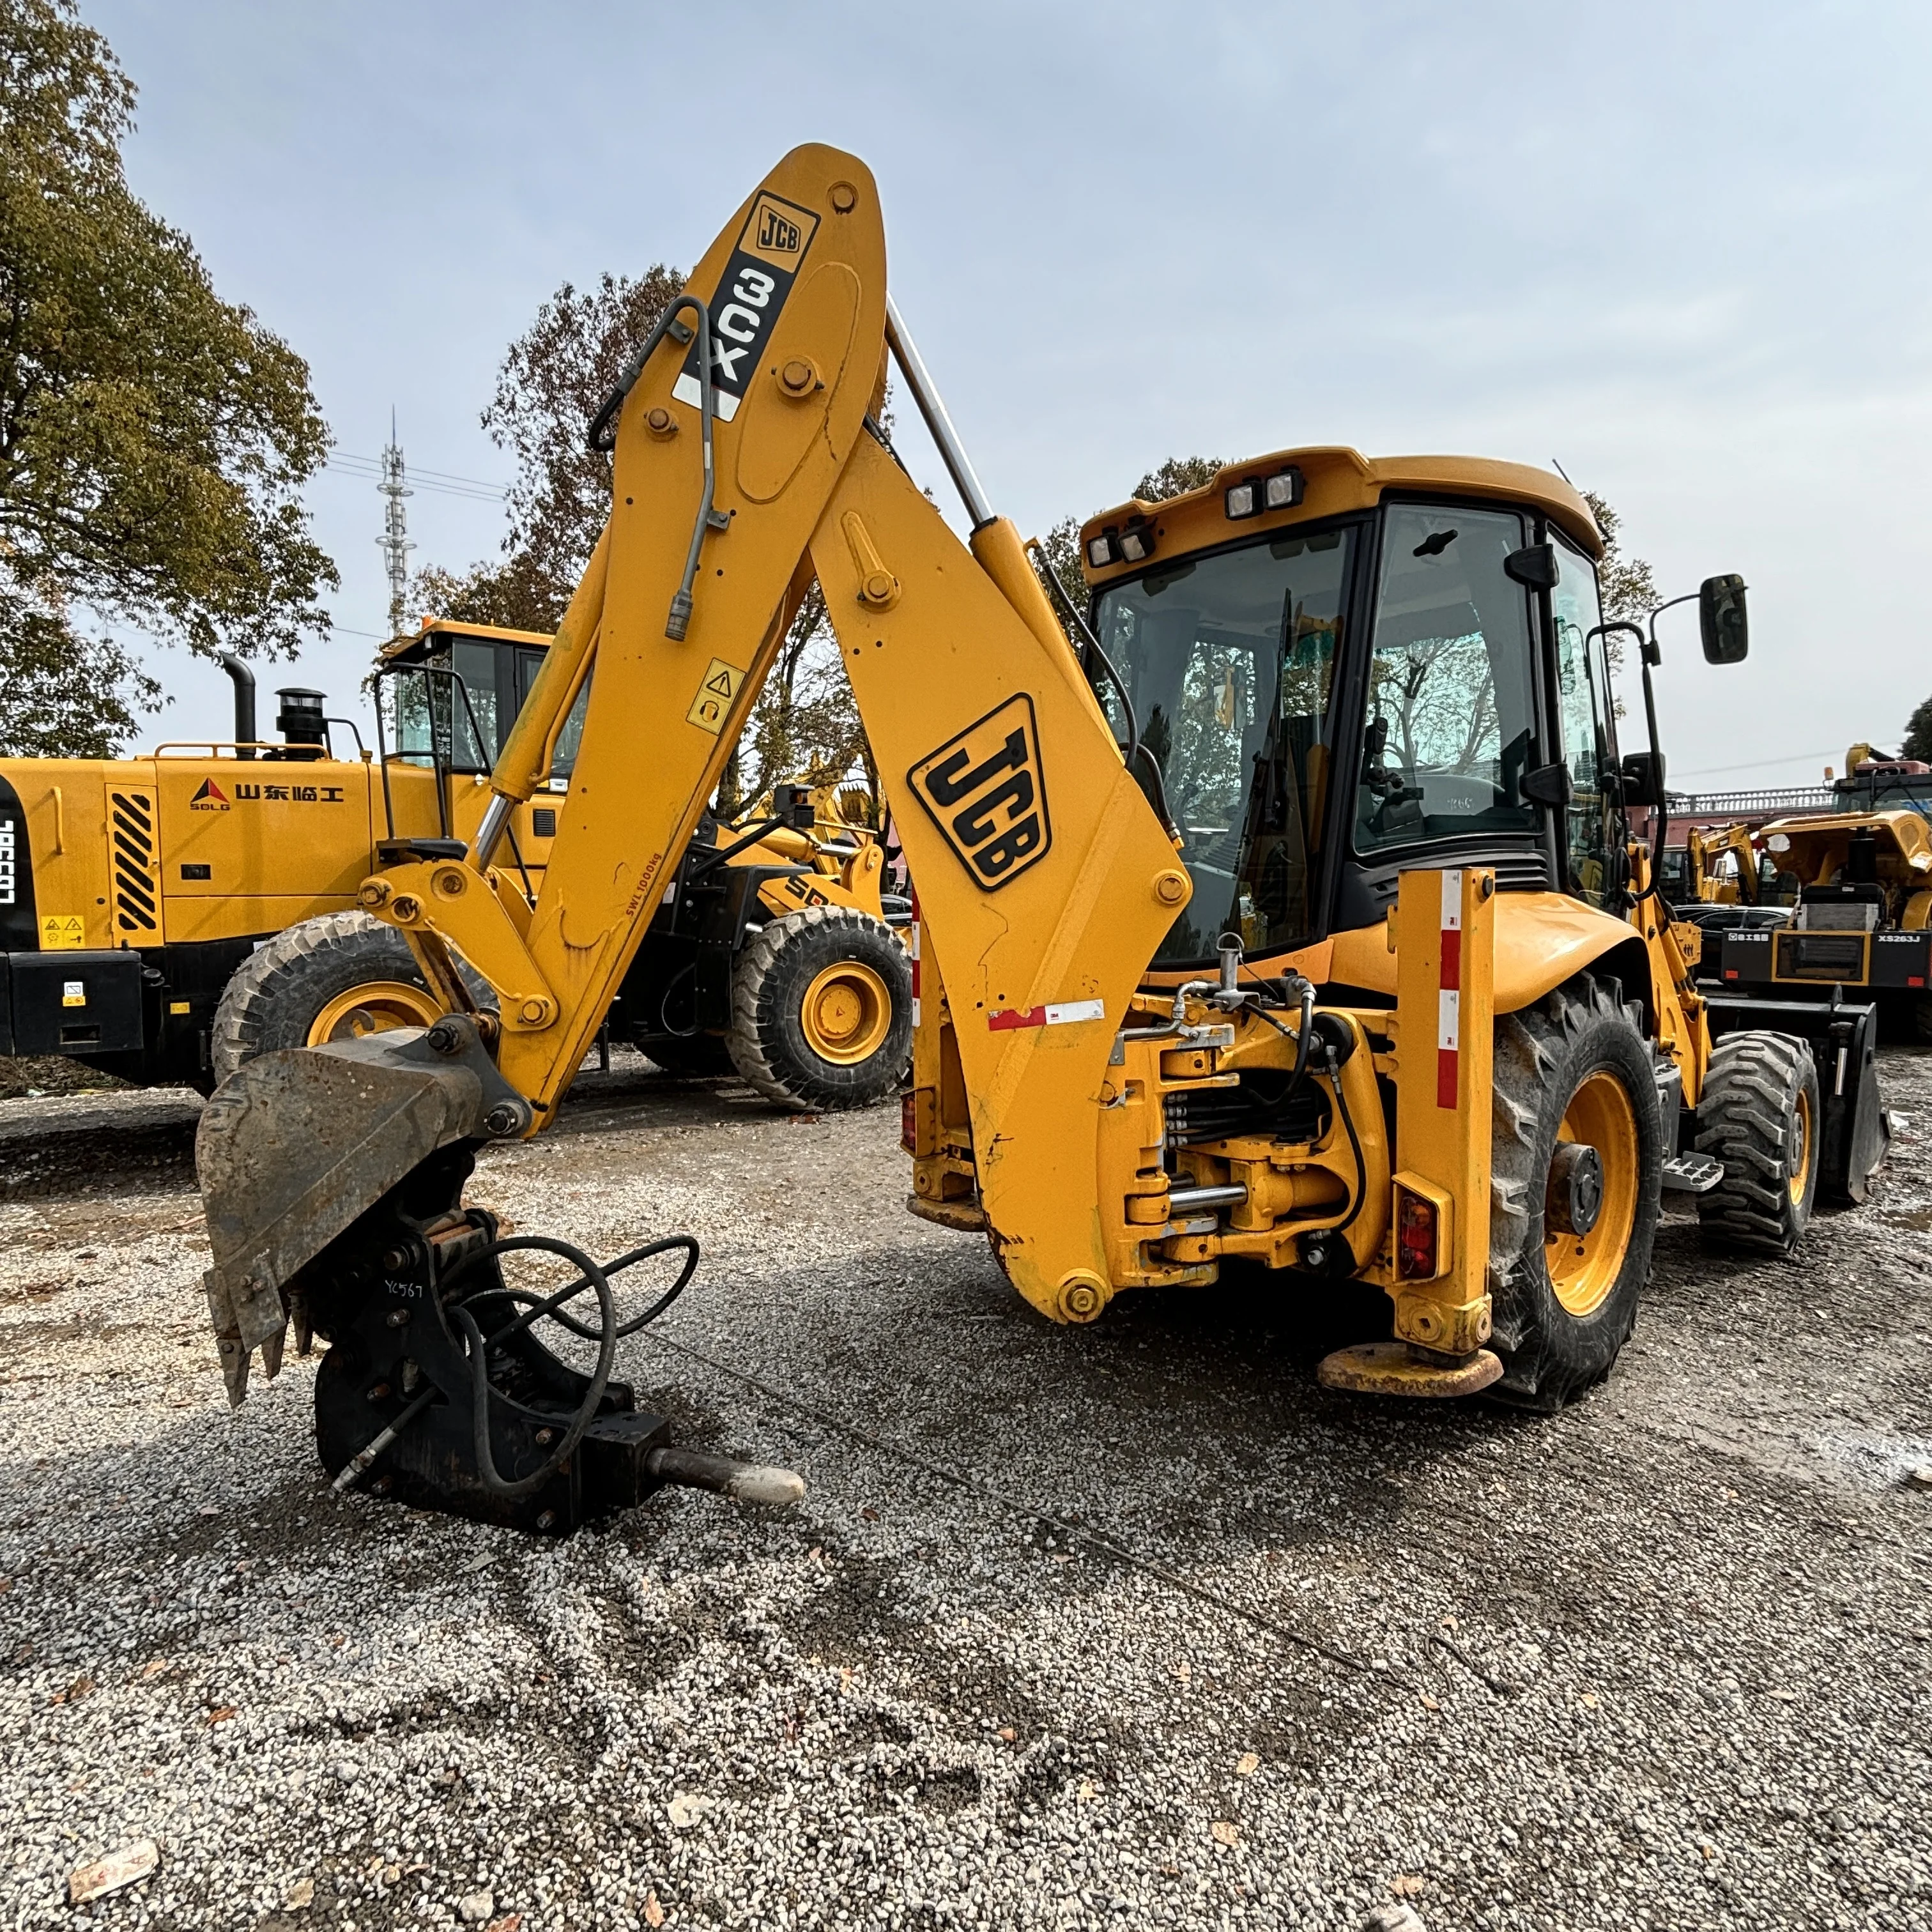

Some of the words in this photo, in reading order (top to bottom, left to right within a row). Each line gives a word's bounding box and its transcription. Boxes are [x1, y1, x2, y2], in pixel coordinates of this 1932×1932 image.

[761, 212, 797, 250] JCB
[696, 268, 775, 383] 3CX
[235, 784, 344, 802] 山东临工
[925, 726, 1040, 878] JCB
[625, 894, 642, 917] SWL
[636, 853, 662, 892] 1000kg
[385, 1280, 422, 1298] YC567
